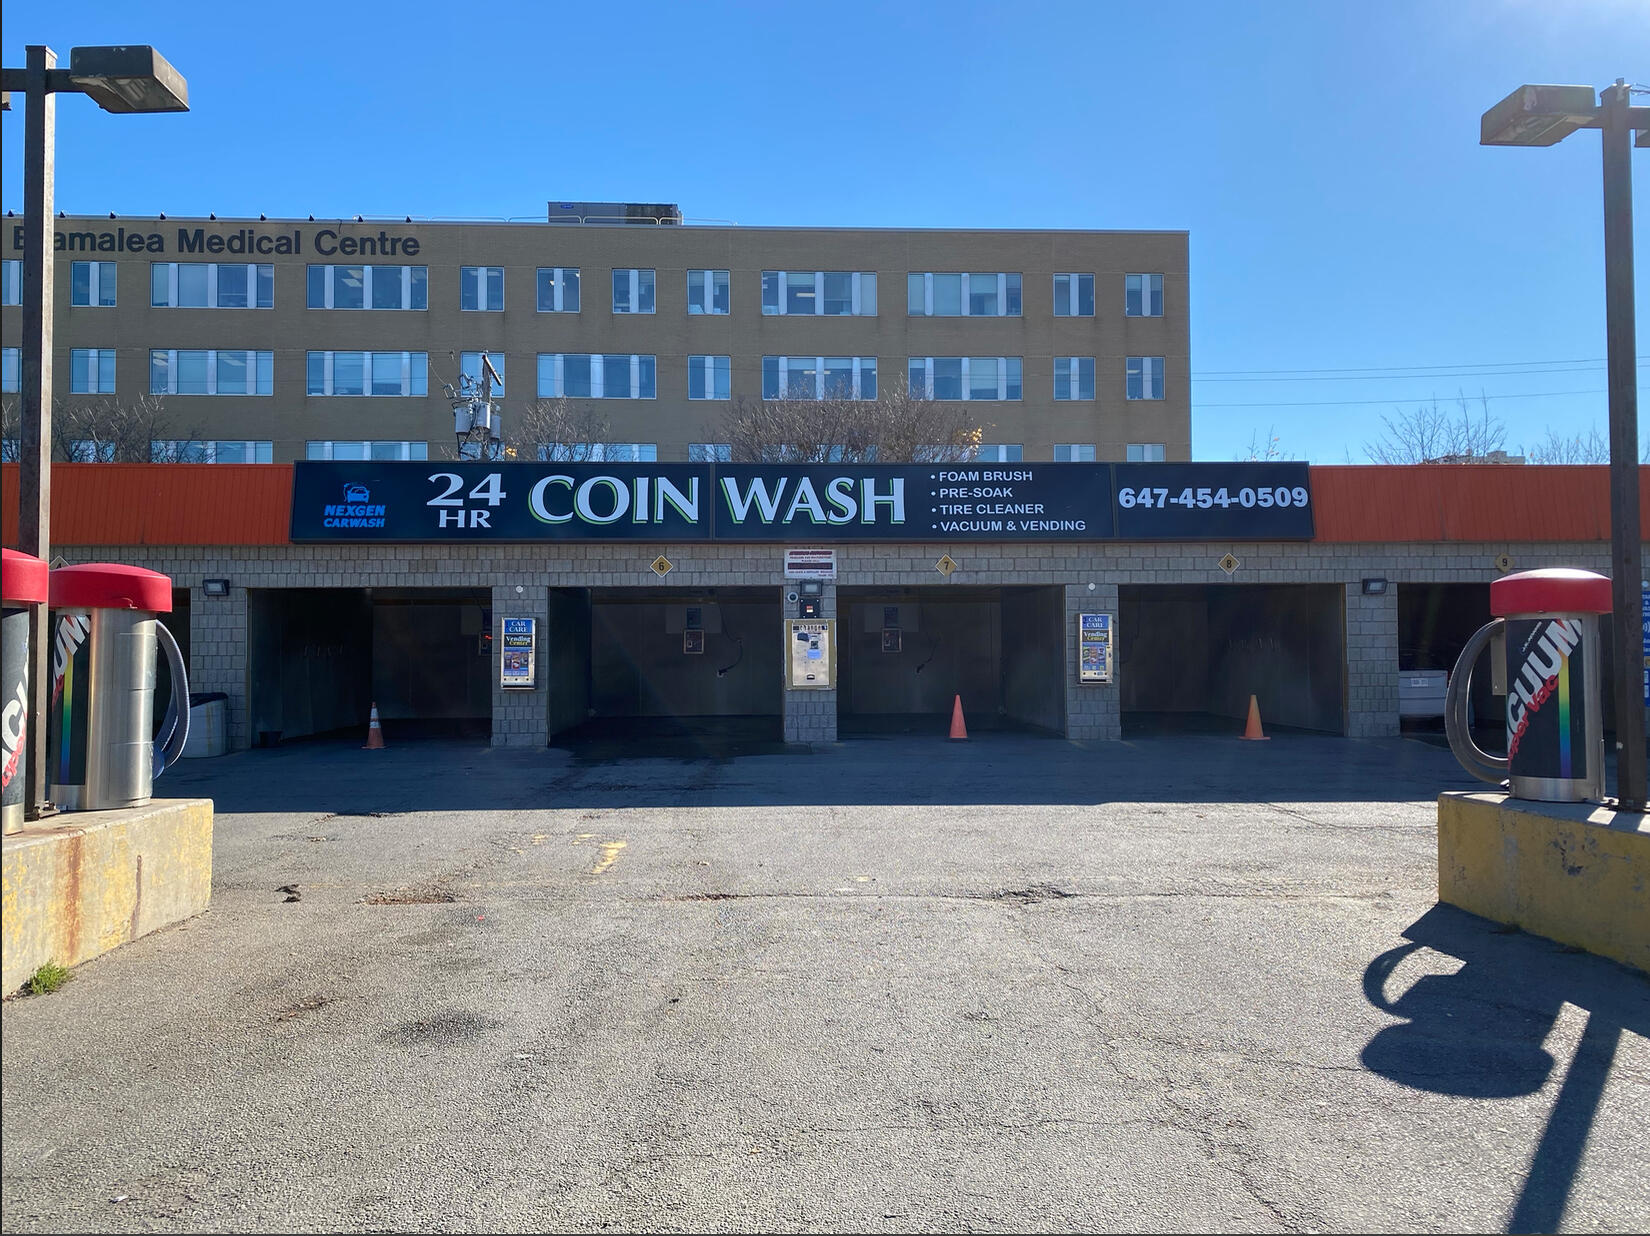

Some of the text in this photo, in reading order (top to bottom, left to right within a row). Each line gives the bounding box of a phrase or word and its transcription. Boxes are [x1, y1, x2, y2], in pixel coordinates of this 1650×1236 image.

[13, 226, 420, 256] amalea Medical Centre
[939, 471, 1033, 482] FOAM BRUSH
[426, 473, 507, 506] 24
[939, 487, 1013, 498] PRE-SOAK
[528, 475, 906, 524] COIN WASH
[1118, 487, 1309, 509] 647-454-0509
[323, 505, 386, 516] NEXGEN
[940, 503, 1044, 515] TIRE CLEANER
[323, 517, 385, 528] CARWASH
[438, 509, 492, 528] HR
[940, 520, 1086, 532] VACUUM & VENDING
[658, 561, 665, 571] 6
[943, 561, 949, 570] 7
[1226, 559, 1232, 569] 8
[1502, 558, 1508, 567] 9
[506, 635, 532, 643] Vending
